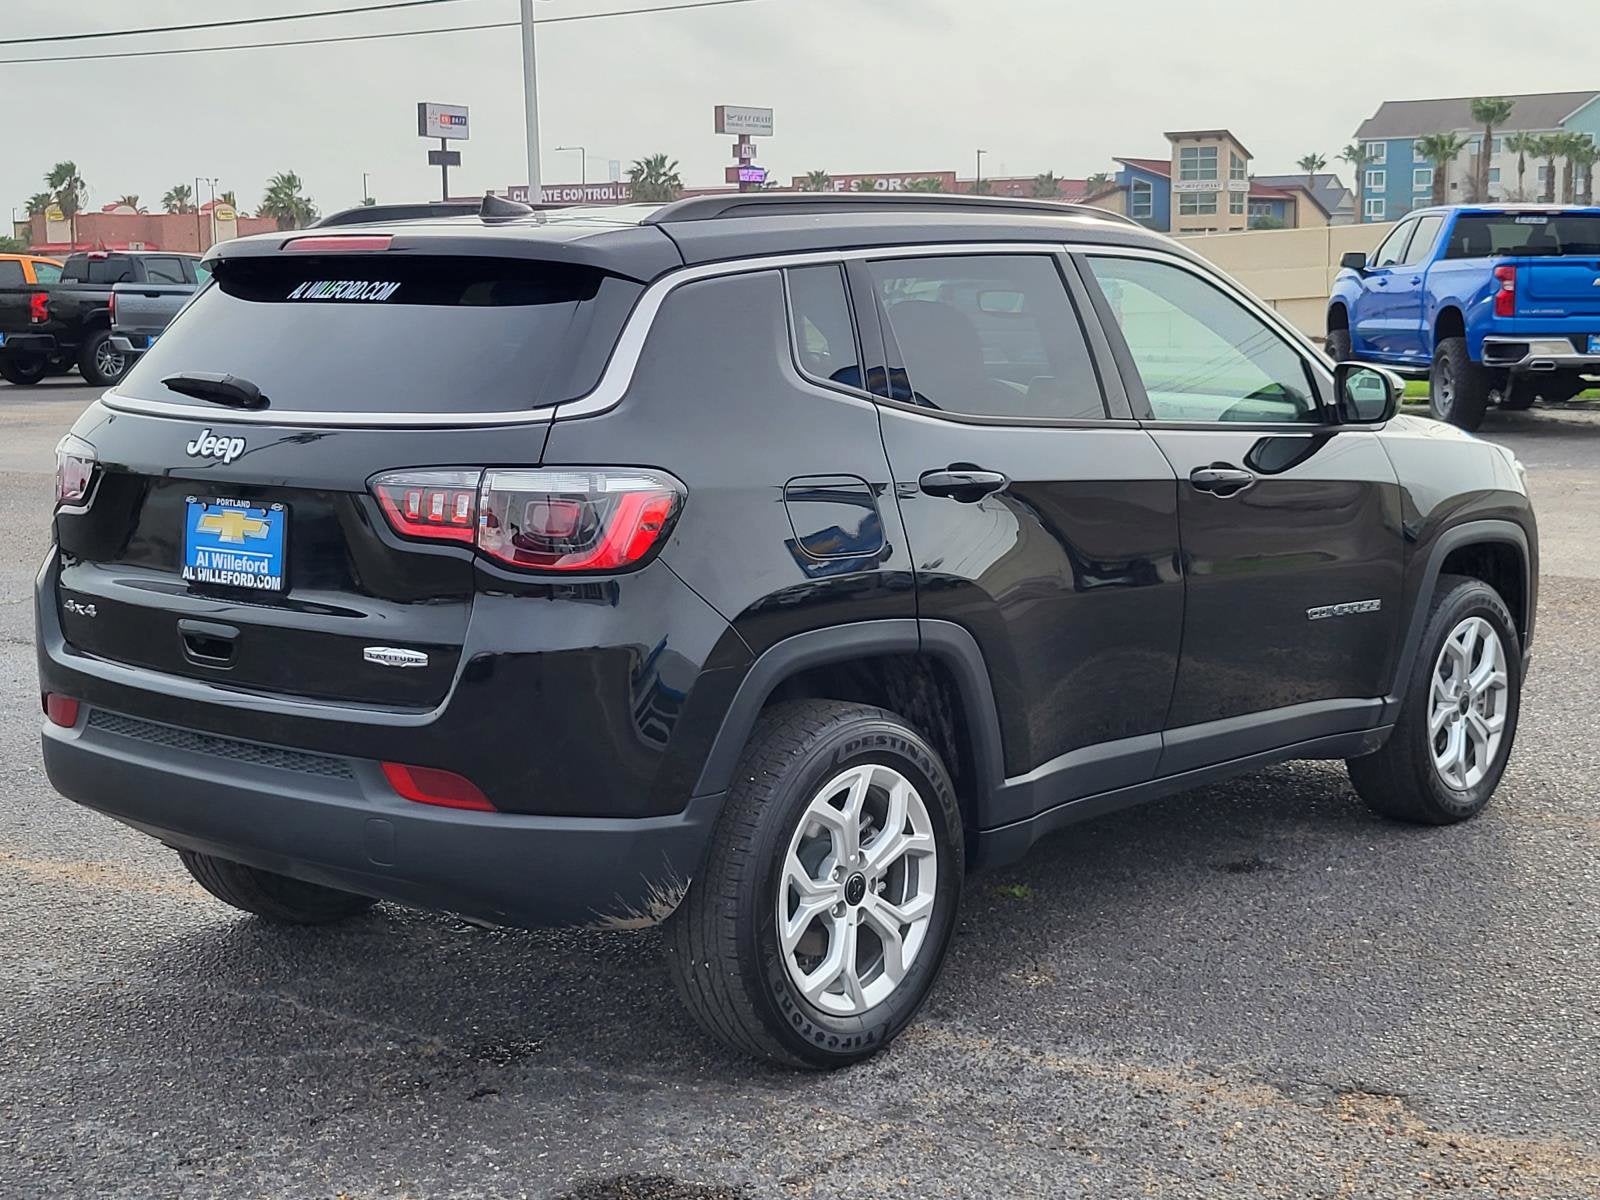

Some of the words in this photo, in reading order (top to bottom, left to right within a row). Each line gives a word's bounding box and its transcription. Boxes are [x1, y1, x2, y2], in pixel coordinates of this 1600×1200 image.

[513, 189, 561, 201] CLATE
[286, 281, 312, 299] AL
[302, 280, 401, 300] WILLEFORD.COM
[187, 429, 245, 463] Jeep
[216, 498, 251, 508] PORTLAND
[196, 551, 209, 567] Al
[212, 553, 269, 574] Willeford
[182, 566, 196, 580] AL
[198, 567, 281, 590] WILLEFORD.COM
[366, 652, 427, 664] LATITUDE
